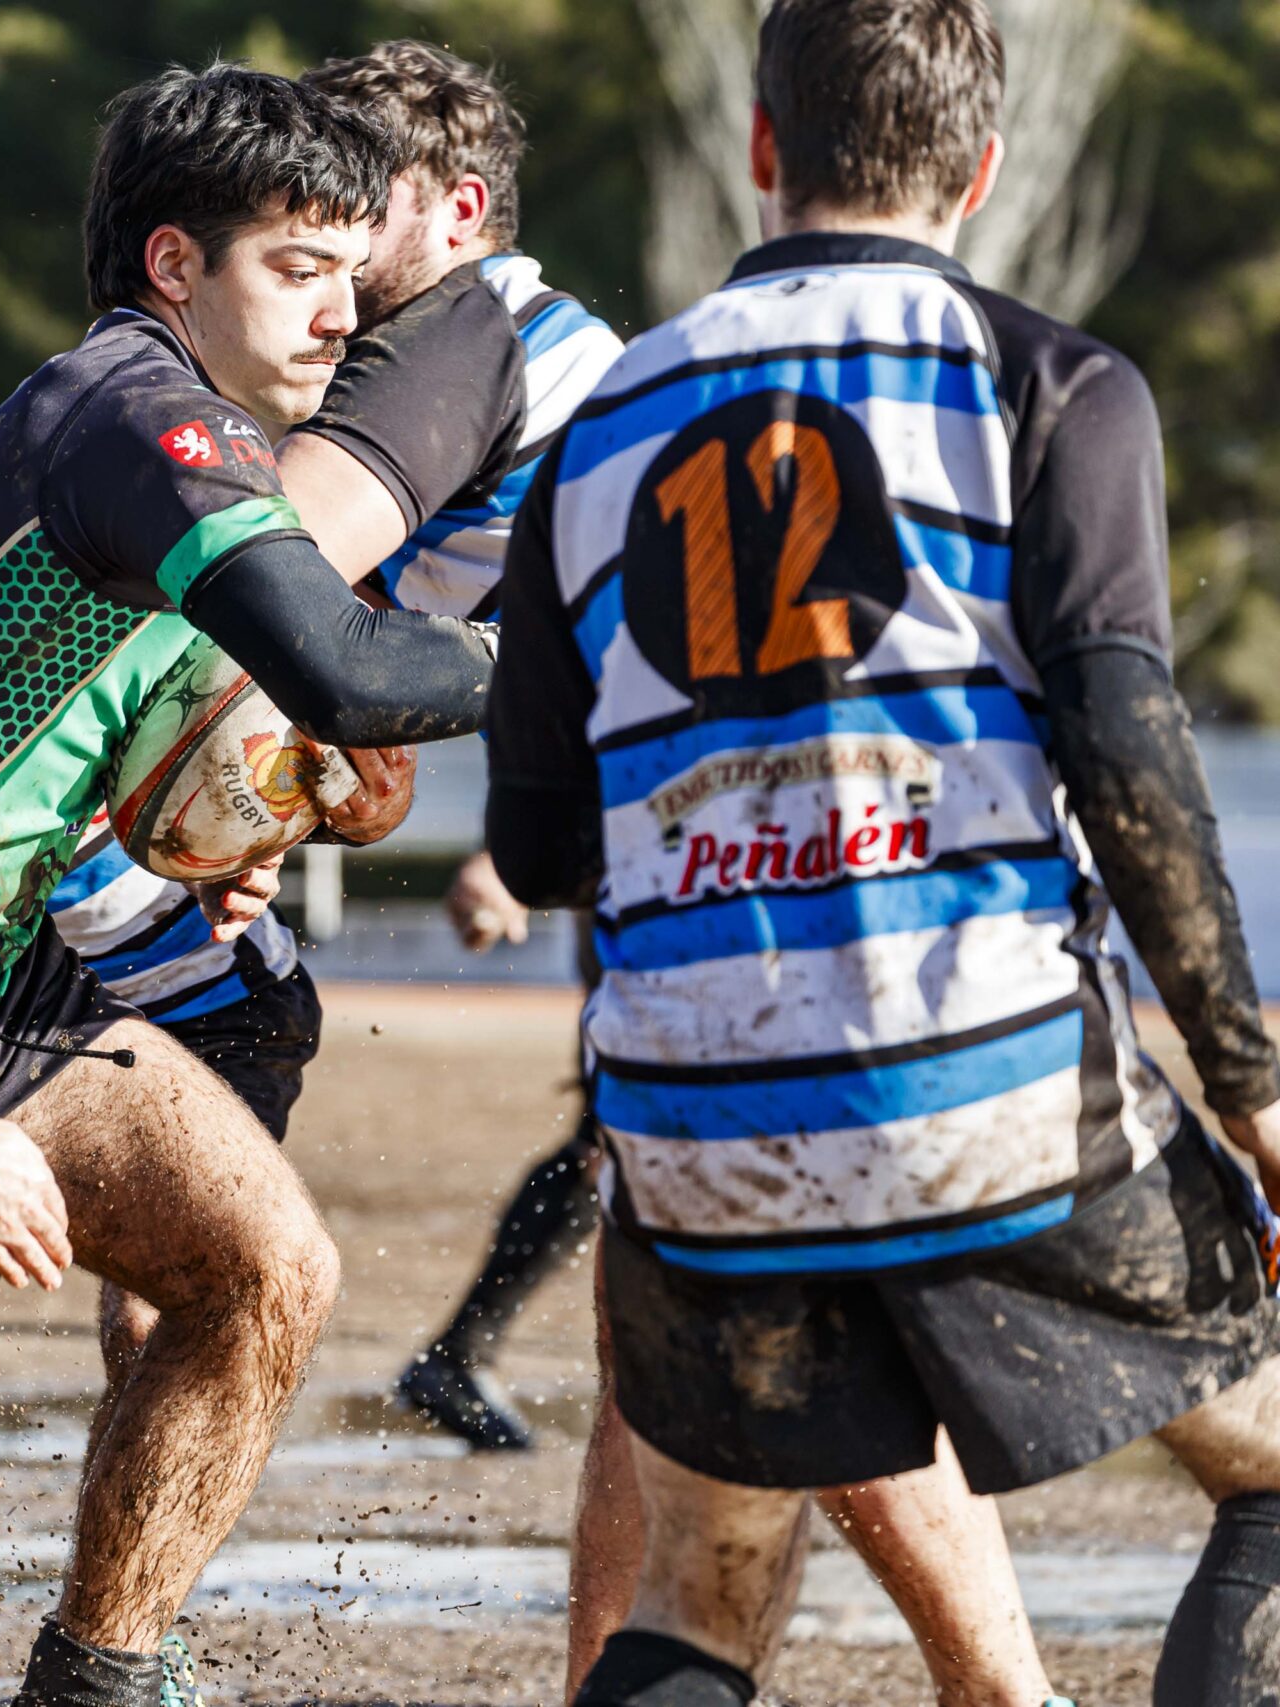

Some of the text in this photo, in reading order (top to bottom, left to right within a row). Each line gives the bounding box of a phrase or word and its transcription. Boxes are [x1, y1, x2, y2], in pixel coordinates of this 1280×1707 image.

[656, 421, 853, 679] 12
[222, 763, 270, 828] RUGBY
[677, 805, 929, 897] Peñalén
